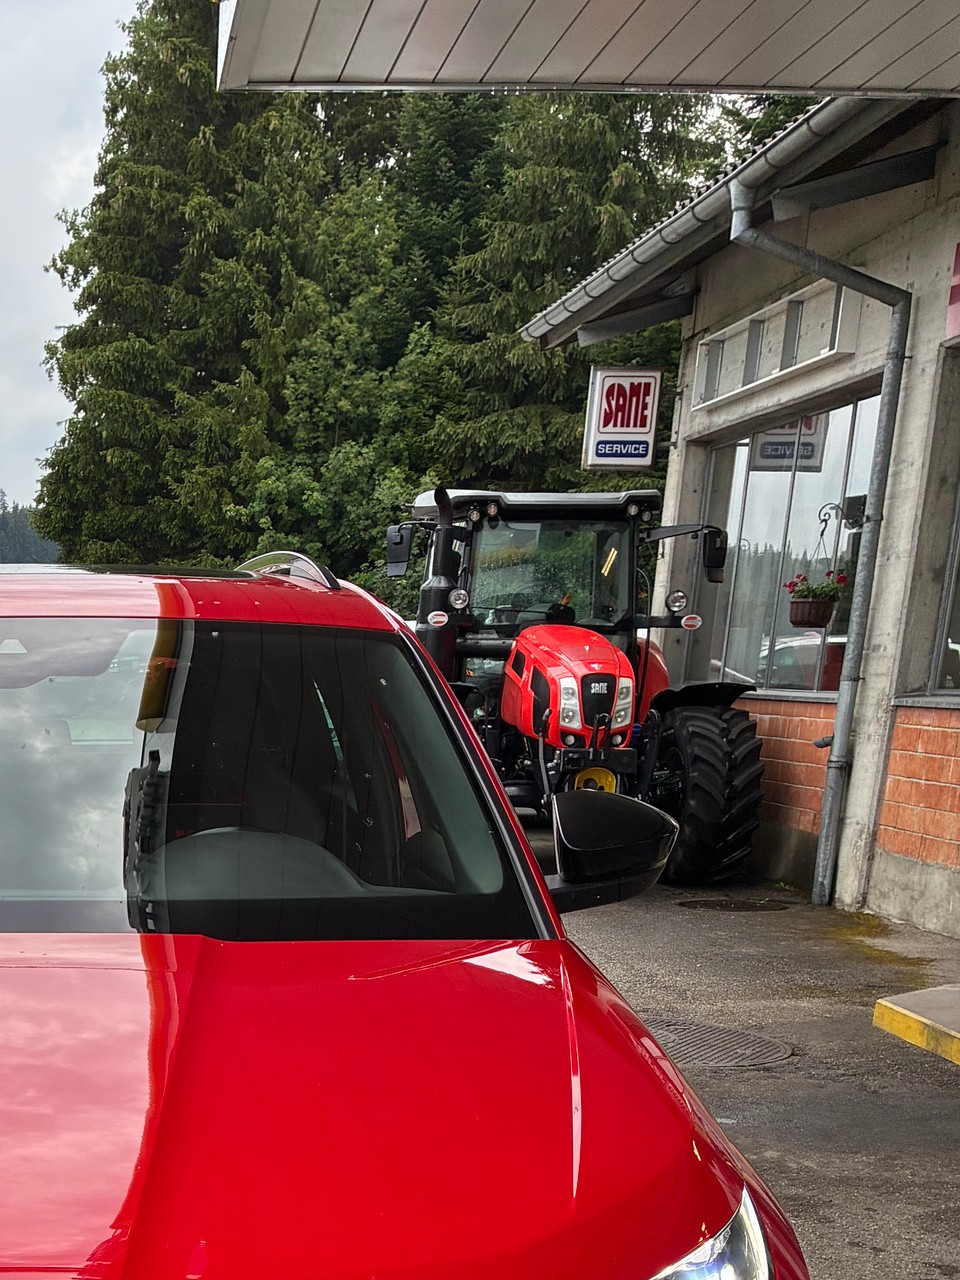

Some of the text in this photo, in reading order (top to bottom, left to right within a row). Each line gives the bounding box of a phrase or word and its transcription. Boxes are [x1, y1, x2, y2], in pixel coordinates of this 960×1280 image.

[602, 382, 651, 428] SAME
[597, 444, 647, 454] SERVICE
[590, 682, 608, 694] SAME
